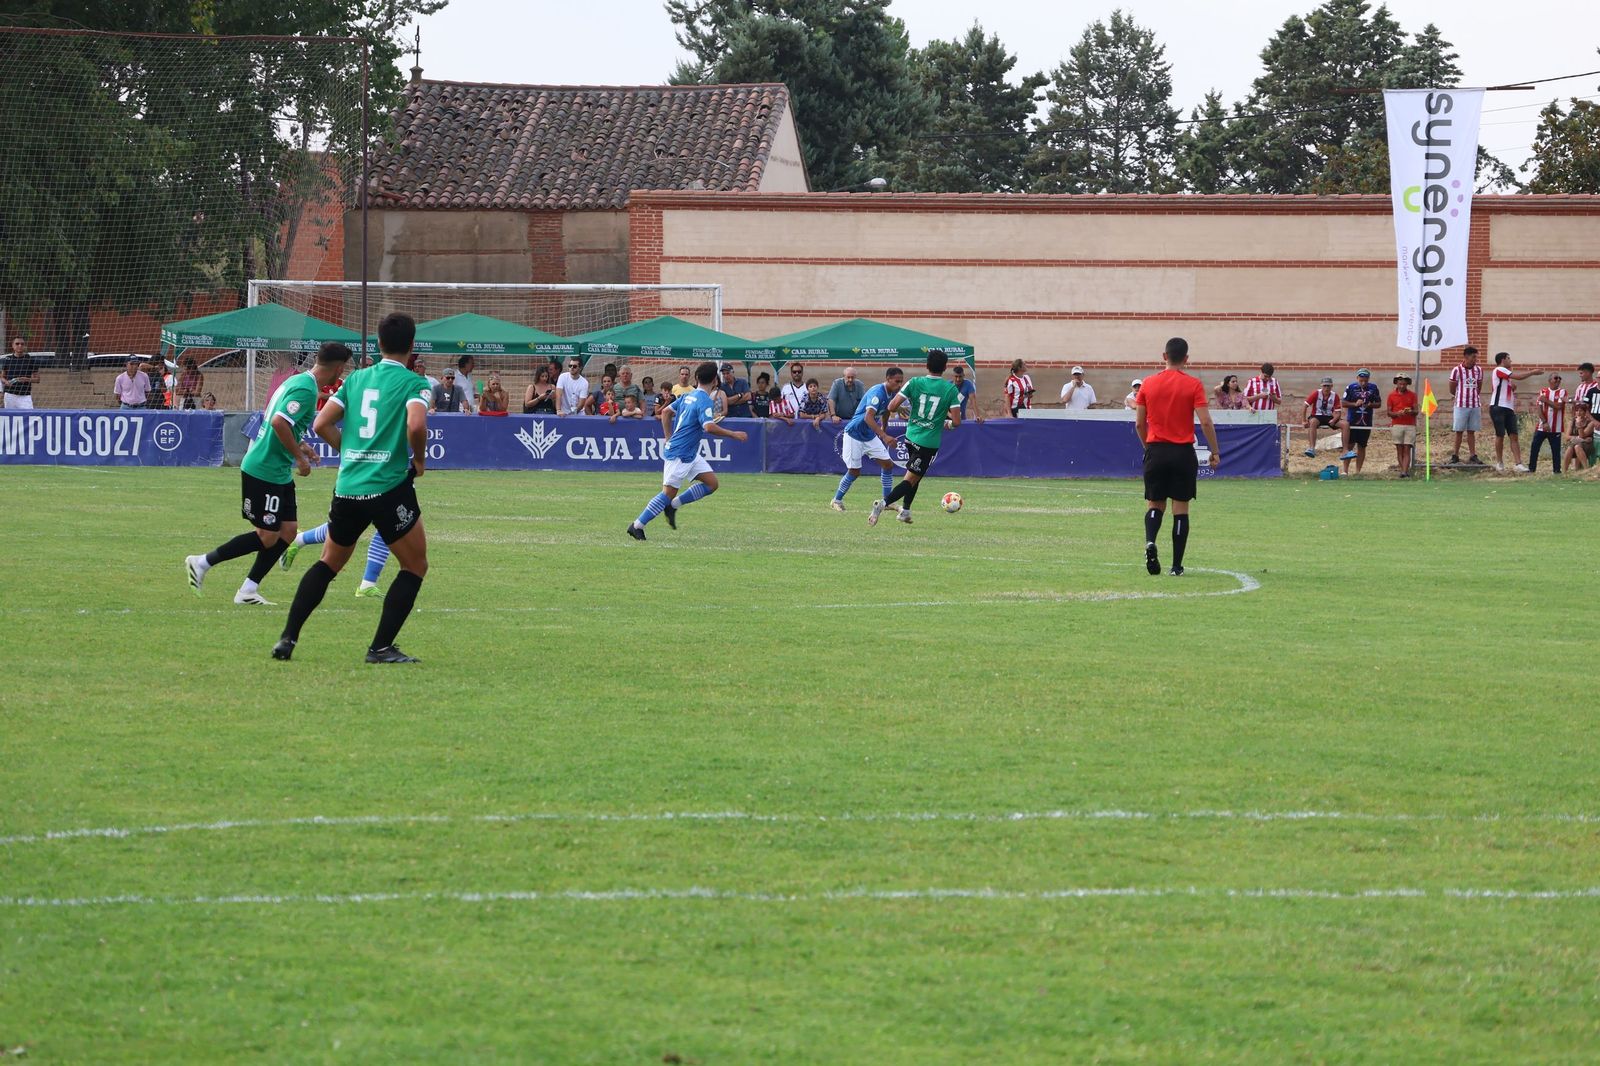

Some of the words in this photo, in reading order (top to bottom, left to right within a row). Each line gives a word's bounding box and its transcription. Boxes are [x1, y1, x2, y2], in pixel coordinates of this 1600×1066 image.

[1411, 92, 1454, 347] synergias
[359, 388, 380, 439] 5
[917, 393, 941, 421] 17
[160, 428, 175, 437] RF
[160, 436, 175, 444] EF
[566, 437, 634, 462] CAJA
[638, 437, 731, 462] RUAL
[264, 494, 280, 513] 10
